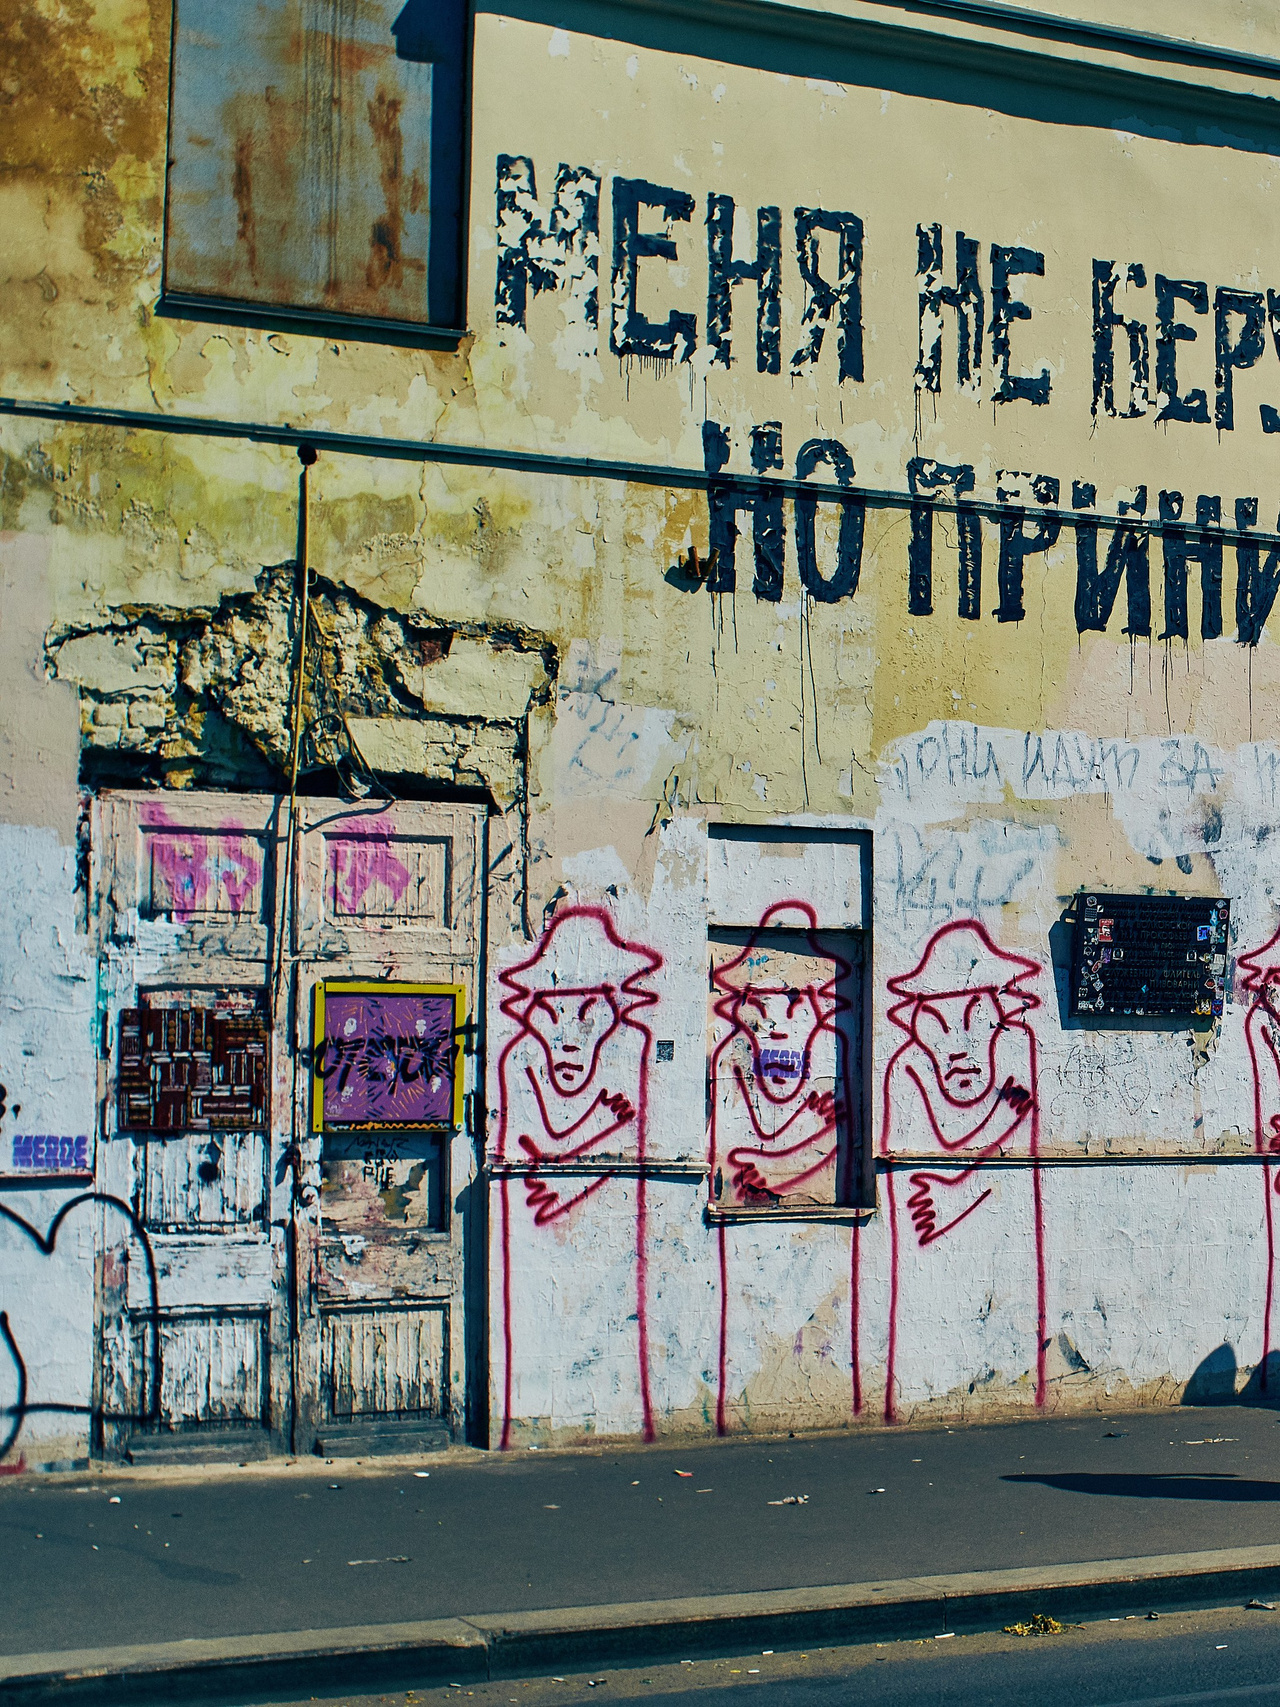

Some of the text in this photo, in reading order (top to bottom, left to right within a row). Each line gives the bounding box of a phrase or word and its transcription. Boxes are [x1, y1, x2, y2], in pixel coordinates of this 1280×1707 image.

[496, 154, 865, 383] МЕНЯ
[914, 221, 1052, 407] НЕ
[701, 419, 868, 605] НО
[1163, 968, 1201, 980] ФЛИГЕЛЬ
